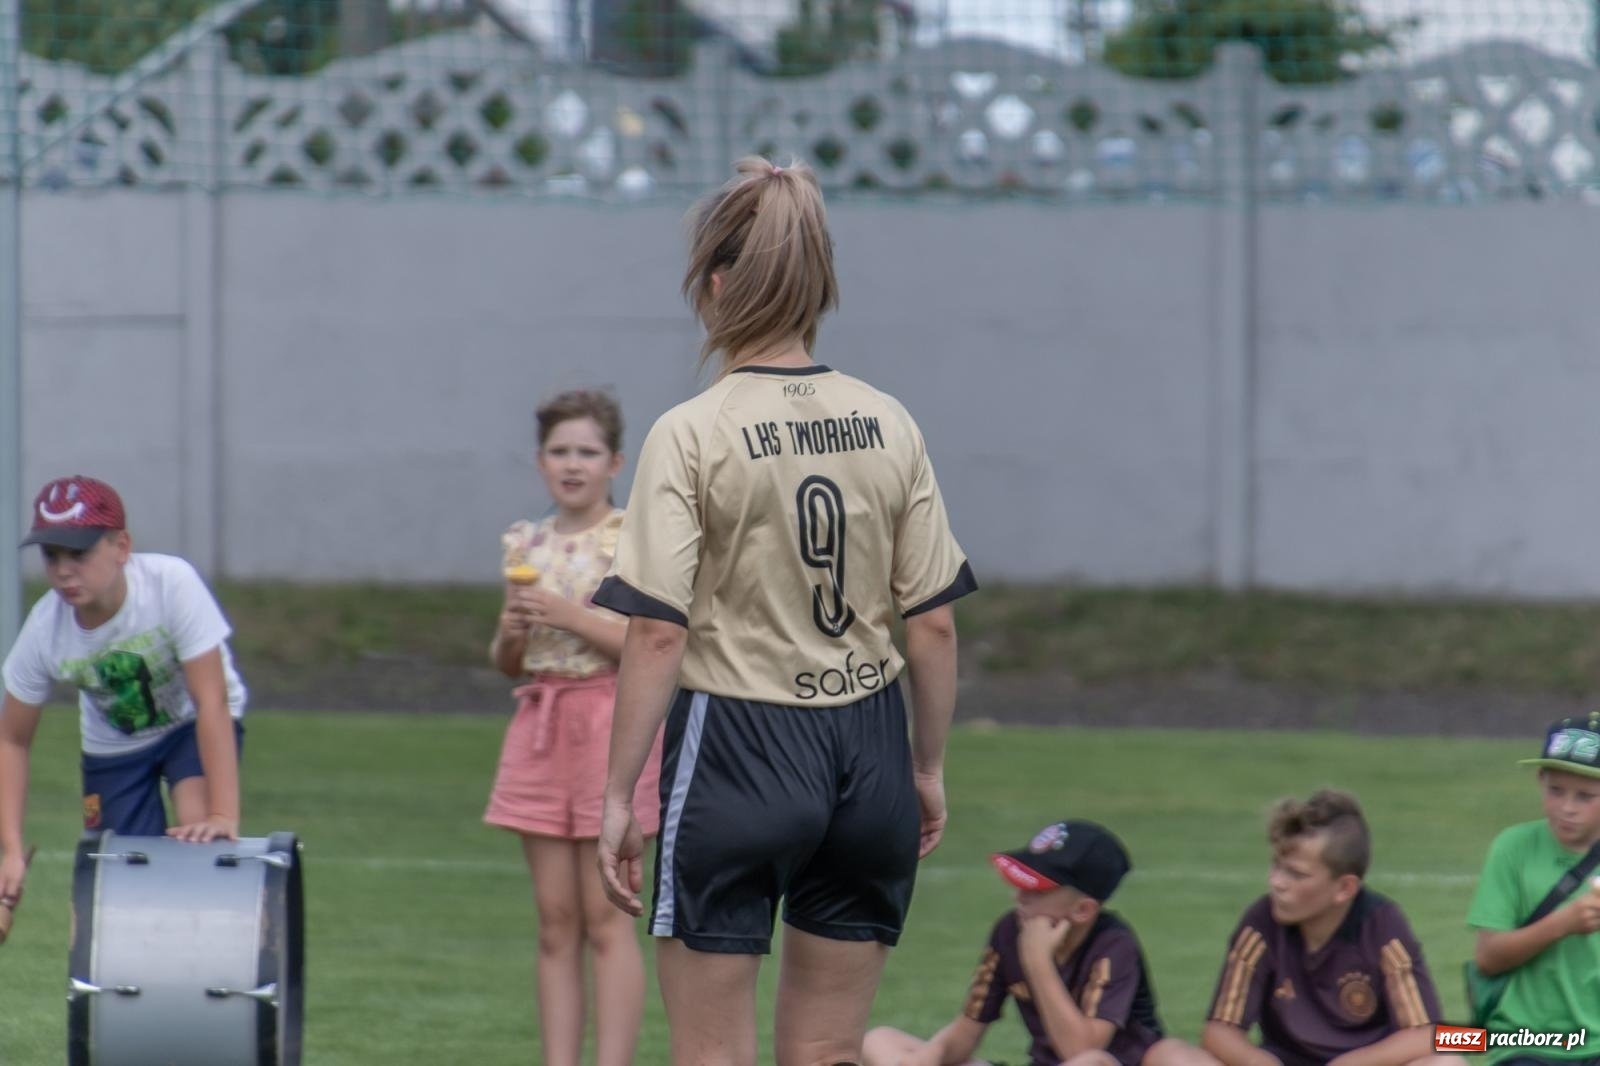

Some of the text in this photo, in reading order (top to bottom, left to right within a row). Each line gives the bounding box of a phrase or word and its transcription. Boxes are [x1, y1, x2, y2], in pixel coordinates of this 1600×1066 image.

[782, 382, 816, 398] 1905
[796, 475, 856, 638] 9
[795, 651, 890, 700] safer
